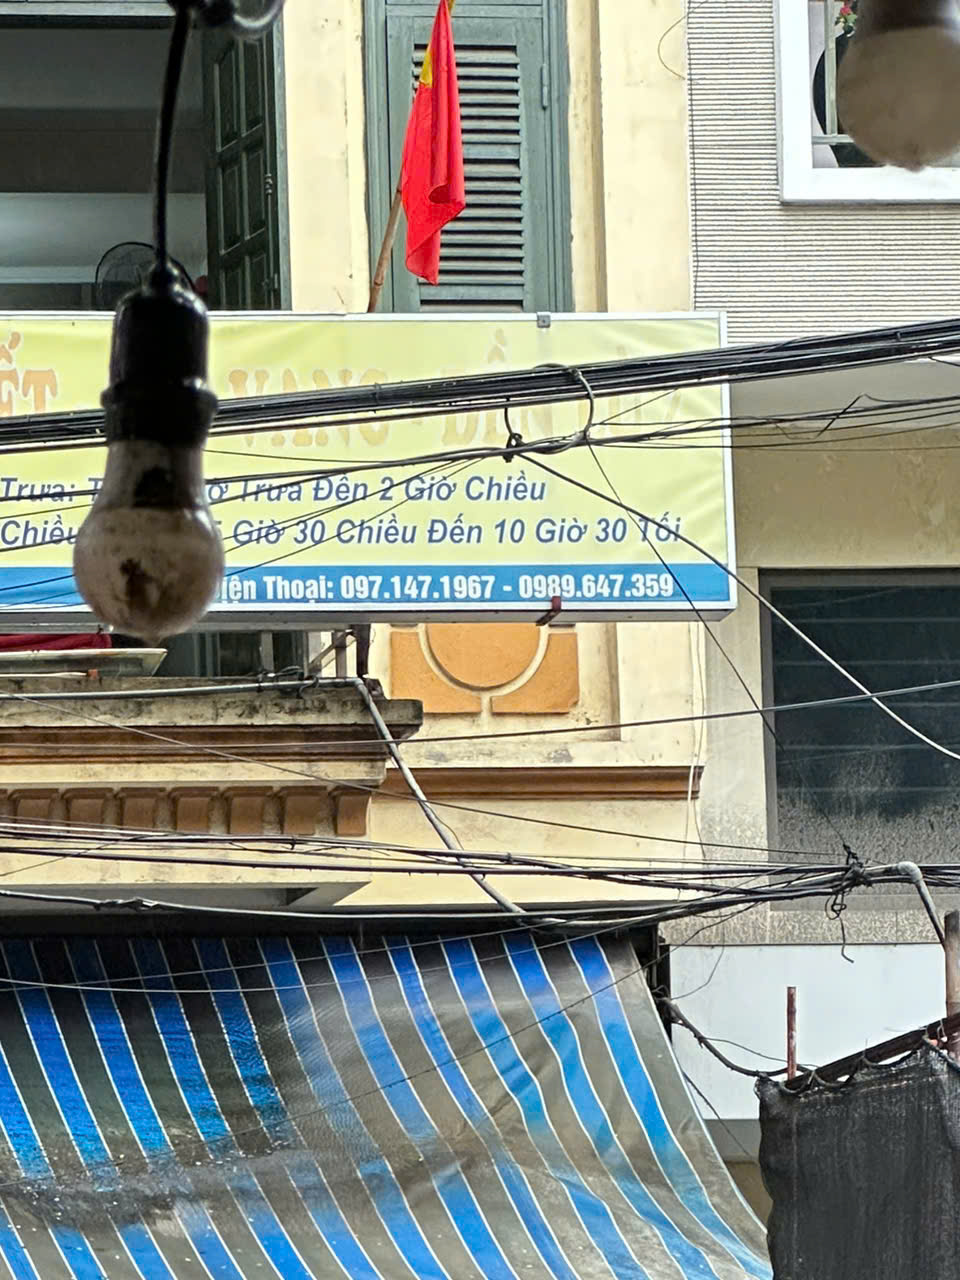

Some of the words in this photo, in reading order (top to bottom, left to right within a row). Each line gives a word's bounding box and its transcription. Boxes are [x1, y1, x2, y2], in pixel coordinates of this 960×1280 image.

[380, 476, 394, 501] 2
[405, 475, 457, 501] Giờ
[465, 470, 547, 501] Chiều
[233, 519, 286, 544] Giờ
[293, 519, 327, 544] 30
[336, 513, 417, 544] Chiều
[428, 513, 483, 544] Đến
[494, 518, 526, 544] 10
[536, 518, 588, 544] Giờ
[595, 517, 628, 543] 30
[639, 511, 682, 543] Tối
[217, 576, 257, 604] iện
[262, 575, 334, 603] Thoại:
[341, 574, 496, 601] 097.147.1967
[518, 573, 675, 599] 0989.647.359
